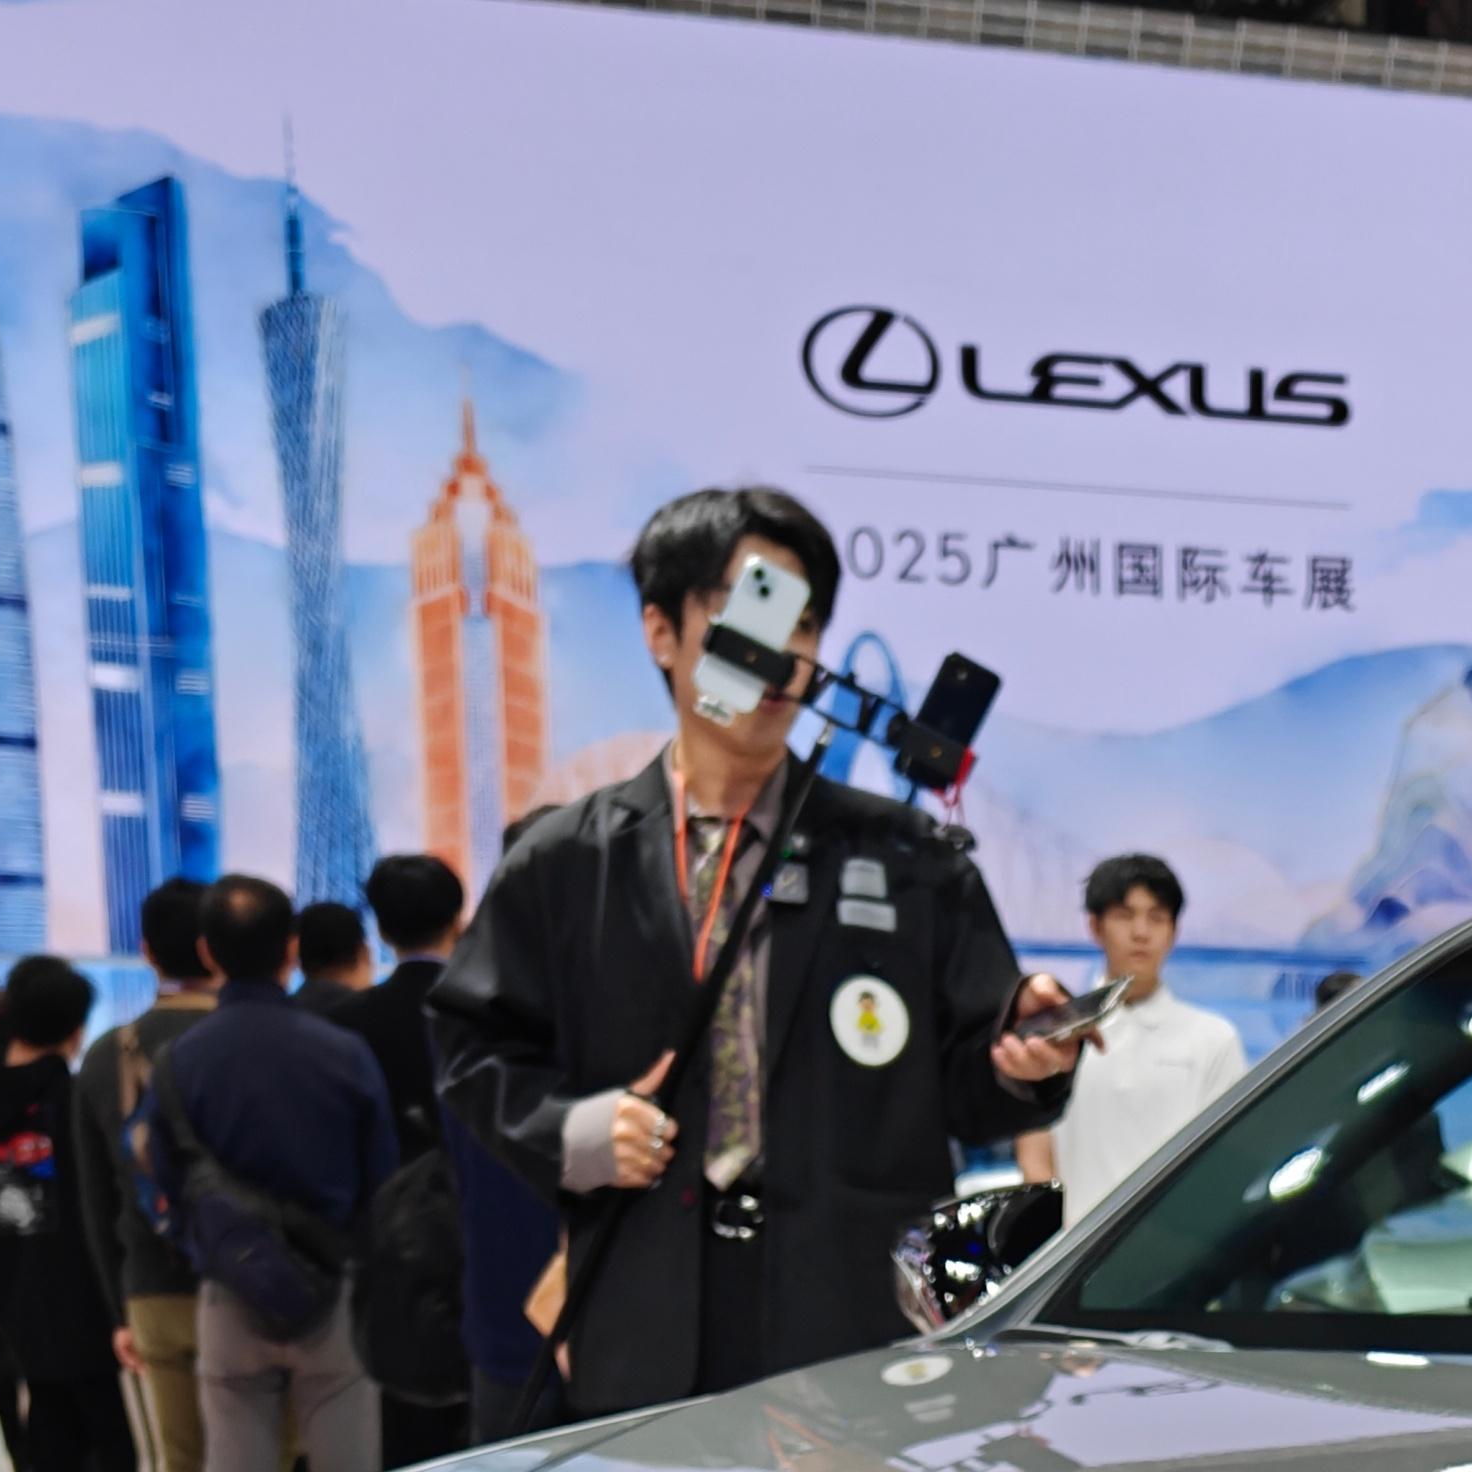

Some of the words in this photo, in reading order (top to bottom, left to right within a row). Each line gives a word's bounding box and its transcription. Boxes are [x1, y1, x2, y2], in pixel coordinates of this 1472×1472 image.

[959, 343, 1353, 428] LEXUS
[844, 525, 1356, 612] 025广州国际车展
